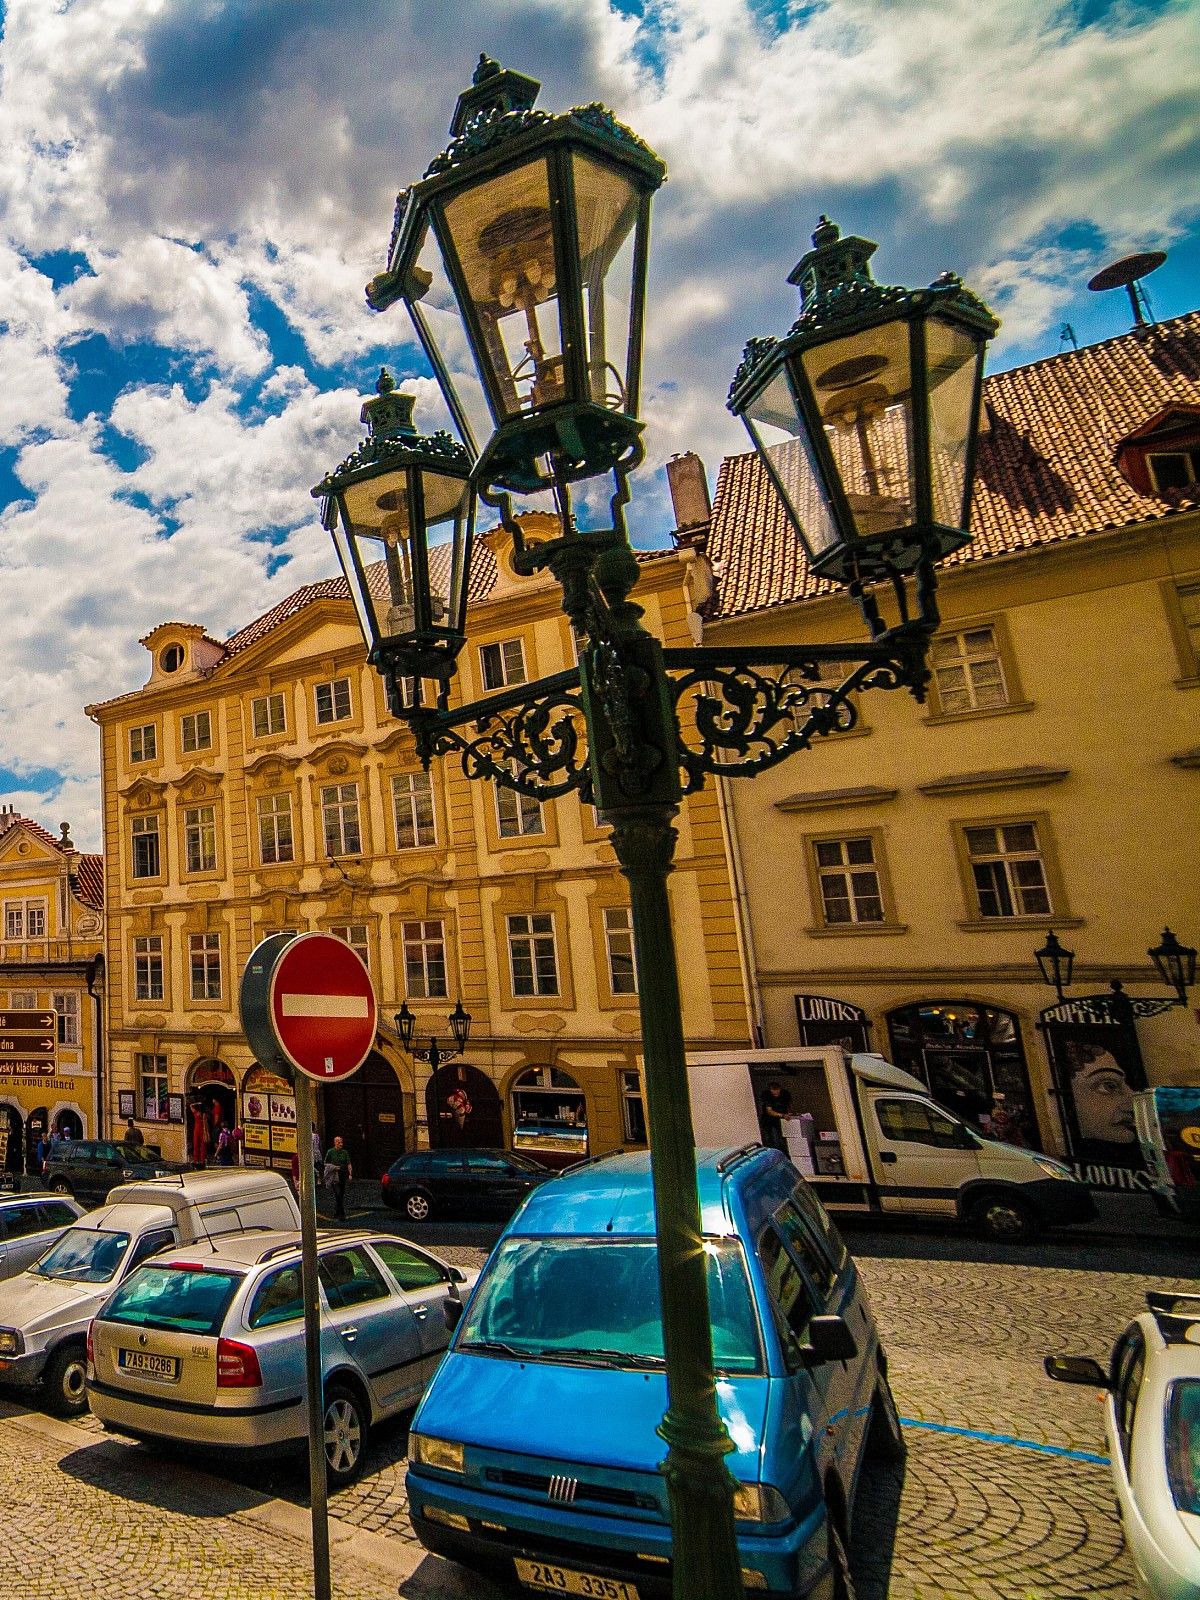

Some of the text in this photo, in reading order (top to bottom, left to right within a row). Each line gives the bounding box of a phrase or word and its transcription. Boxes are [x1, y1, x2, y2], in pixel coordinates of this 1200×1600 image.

[799, 997, 861, 1020] LOUTKY
[16, 1061, 39, 1073] klášter
[127, 1352, 172, 1373] 7A9 0286
[530, 1564, 567, 1588] 2A3
[580, 1575, 630, 1600] 3351
